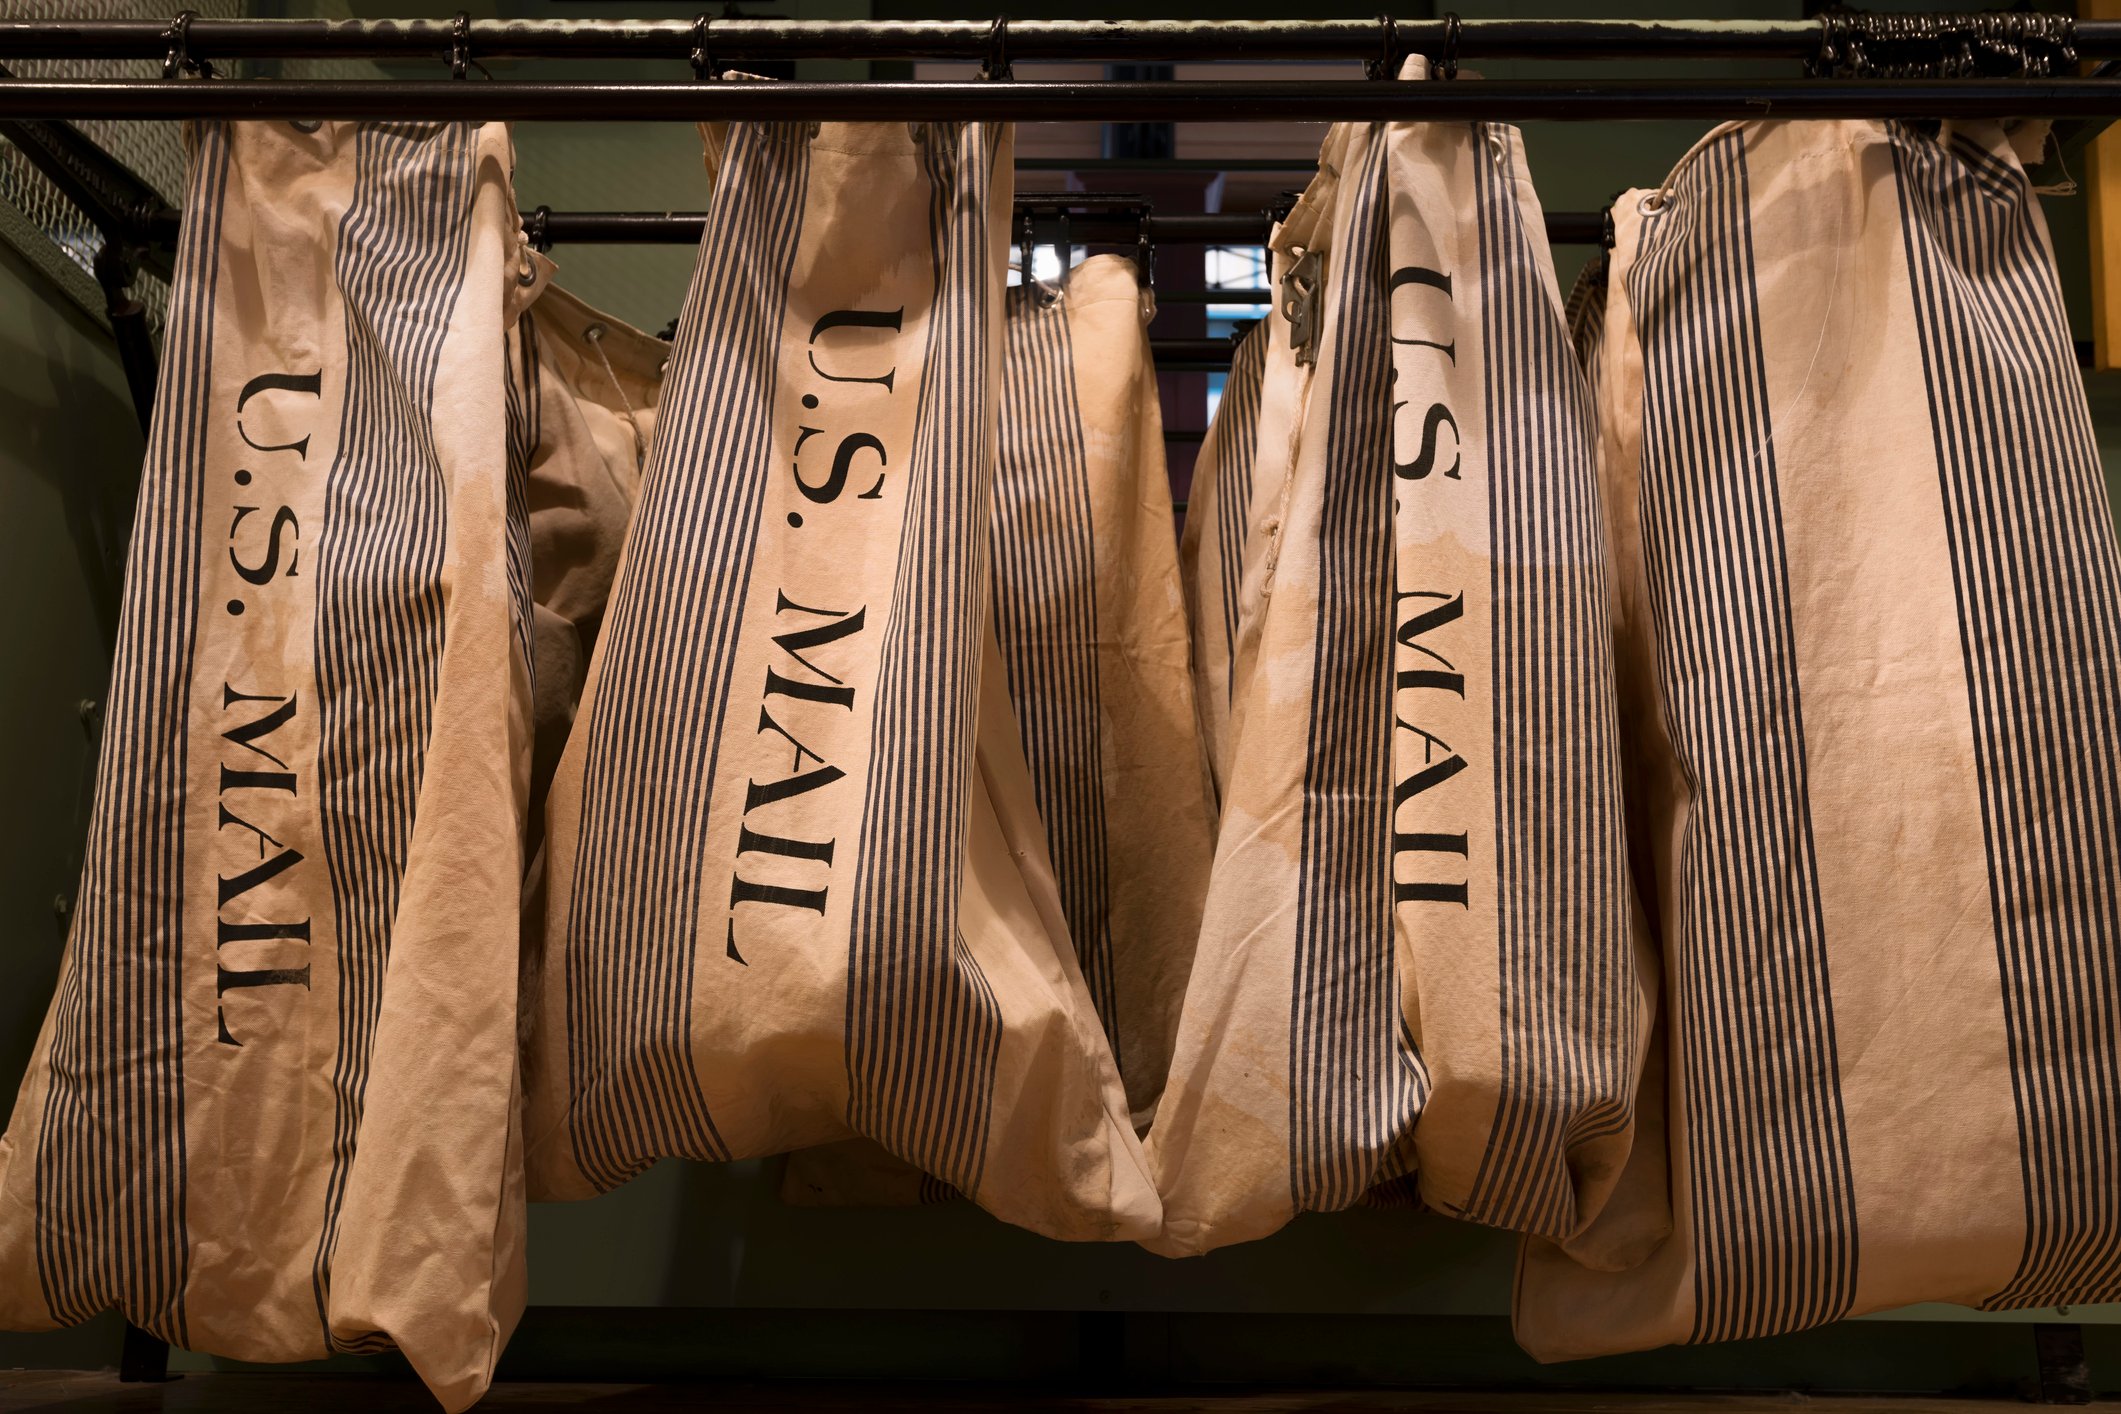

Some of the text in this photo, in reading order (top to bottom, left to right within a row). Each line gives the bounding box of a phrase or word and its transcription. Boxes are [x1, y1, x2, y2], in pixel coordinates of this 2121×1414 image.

[217, 368, 322, 1047] U.S. MAIL
[726, 305, 904, 967] U.S. MAIL
